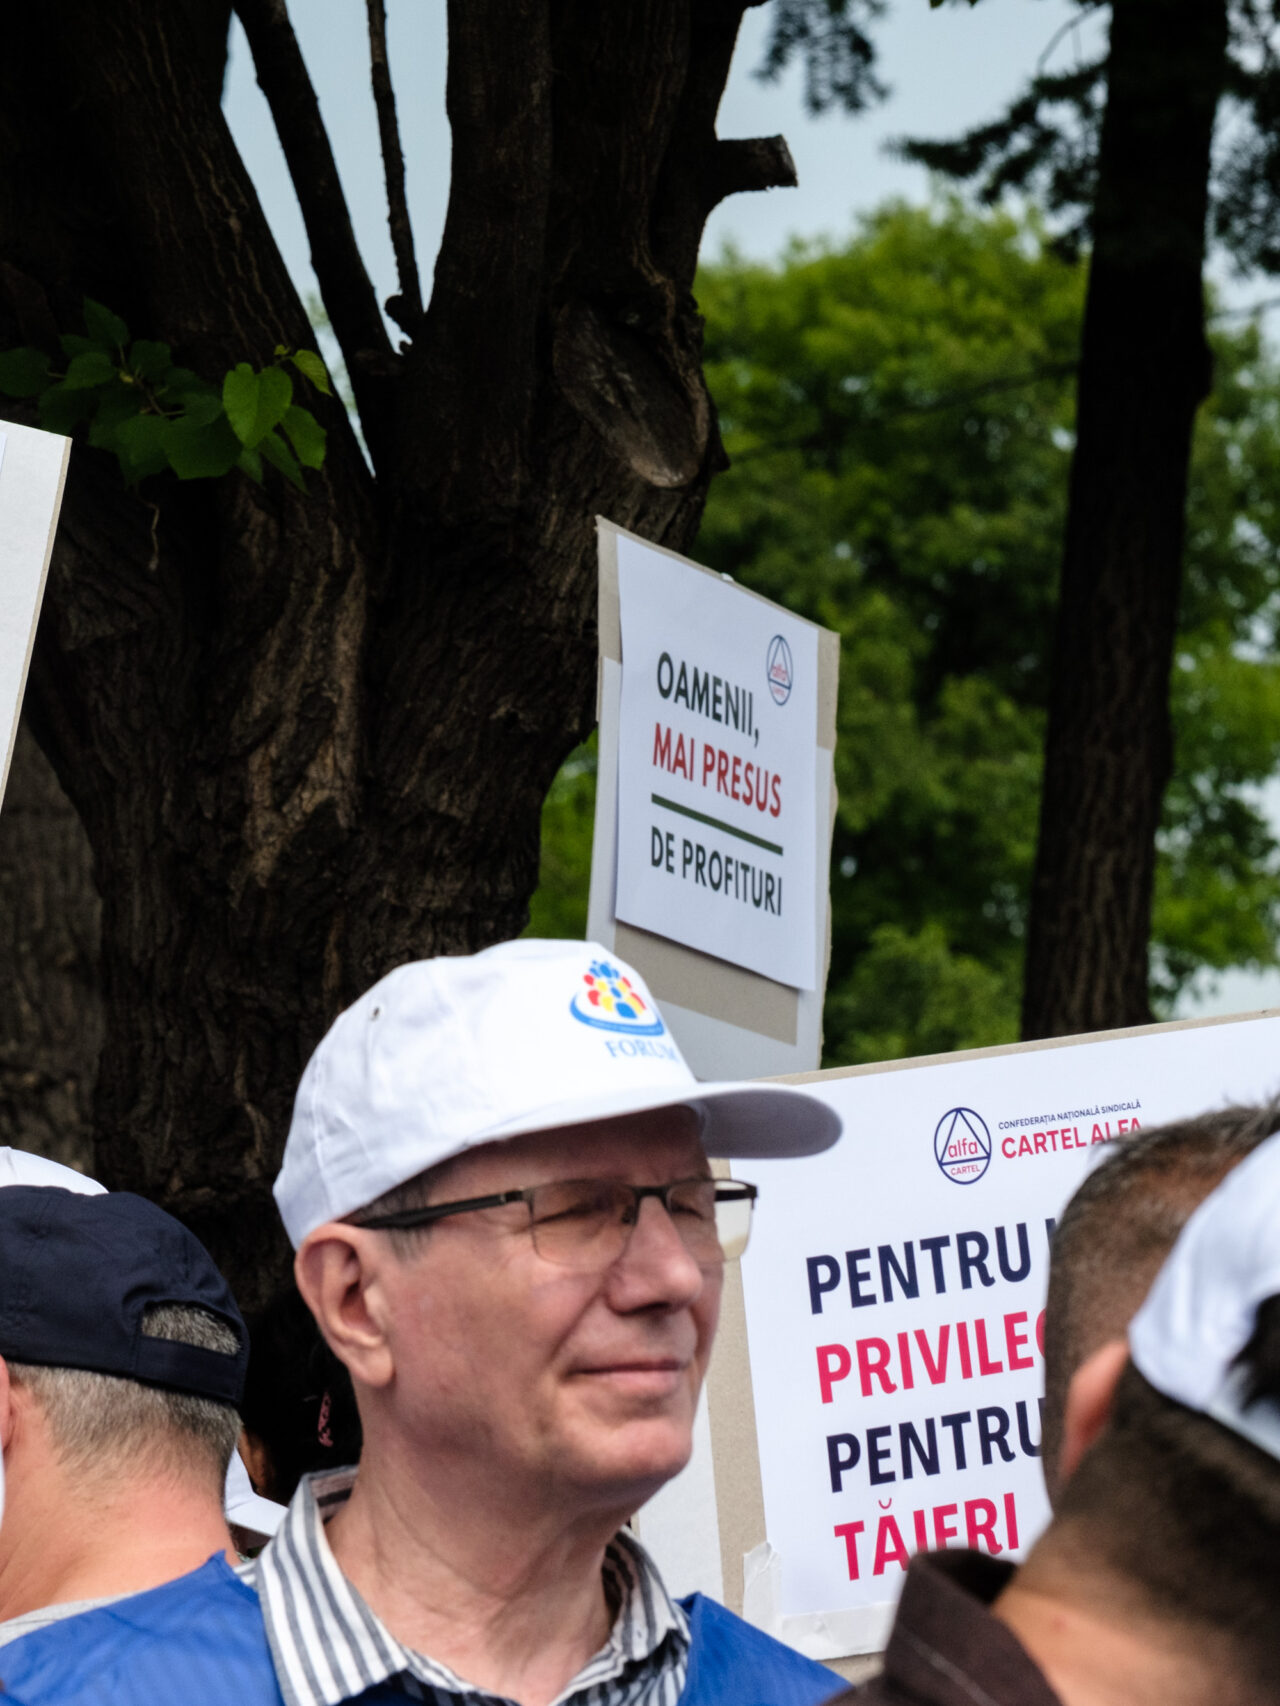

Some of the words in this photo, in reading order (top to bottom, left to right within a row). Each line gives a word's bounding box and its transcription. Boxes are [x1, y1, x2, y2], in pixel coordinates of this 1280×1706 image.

[657, 651, 760, 748] OAMENII,
[653, 722, 695, 782] MAI
[703, 743, 782, 818] PRESUS
[651, 825, 675, 875] DE
[682, 838, 782, 916] PROFITURI
[998, 1113, 1056, 1130] CONFEDERAȚIA
[1057, 1105, 1101, 1122] NAȚIONALĂ
[1101, 1098, 1142, 1114] SINDICALĂ
[1001, 1127, 1087, 1159] CARTEL
[948, 1138, 978, 1158] alfa
[950, 1164, 980, 1176] CARTEL
[806, 1222, 1031, 1315] PENTRU
